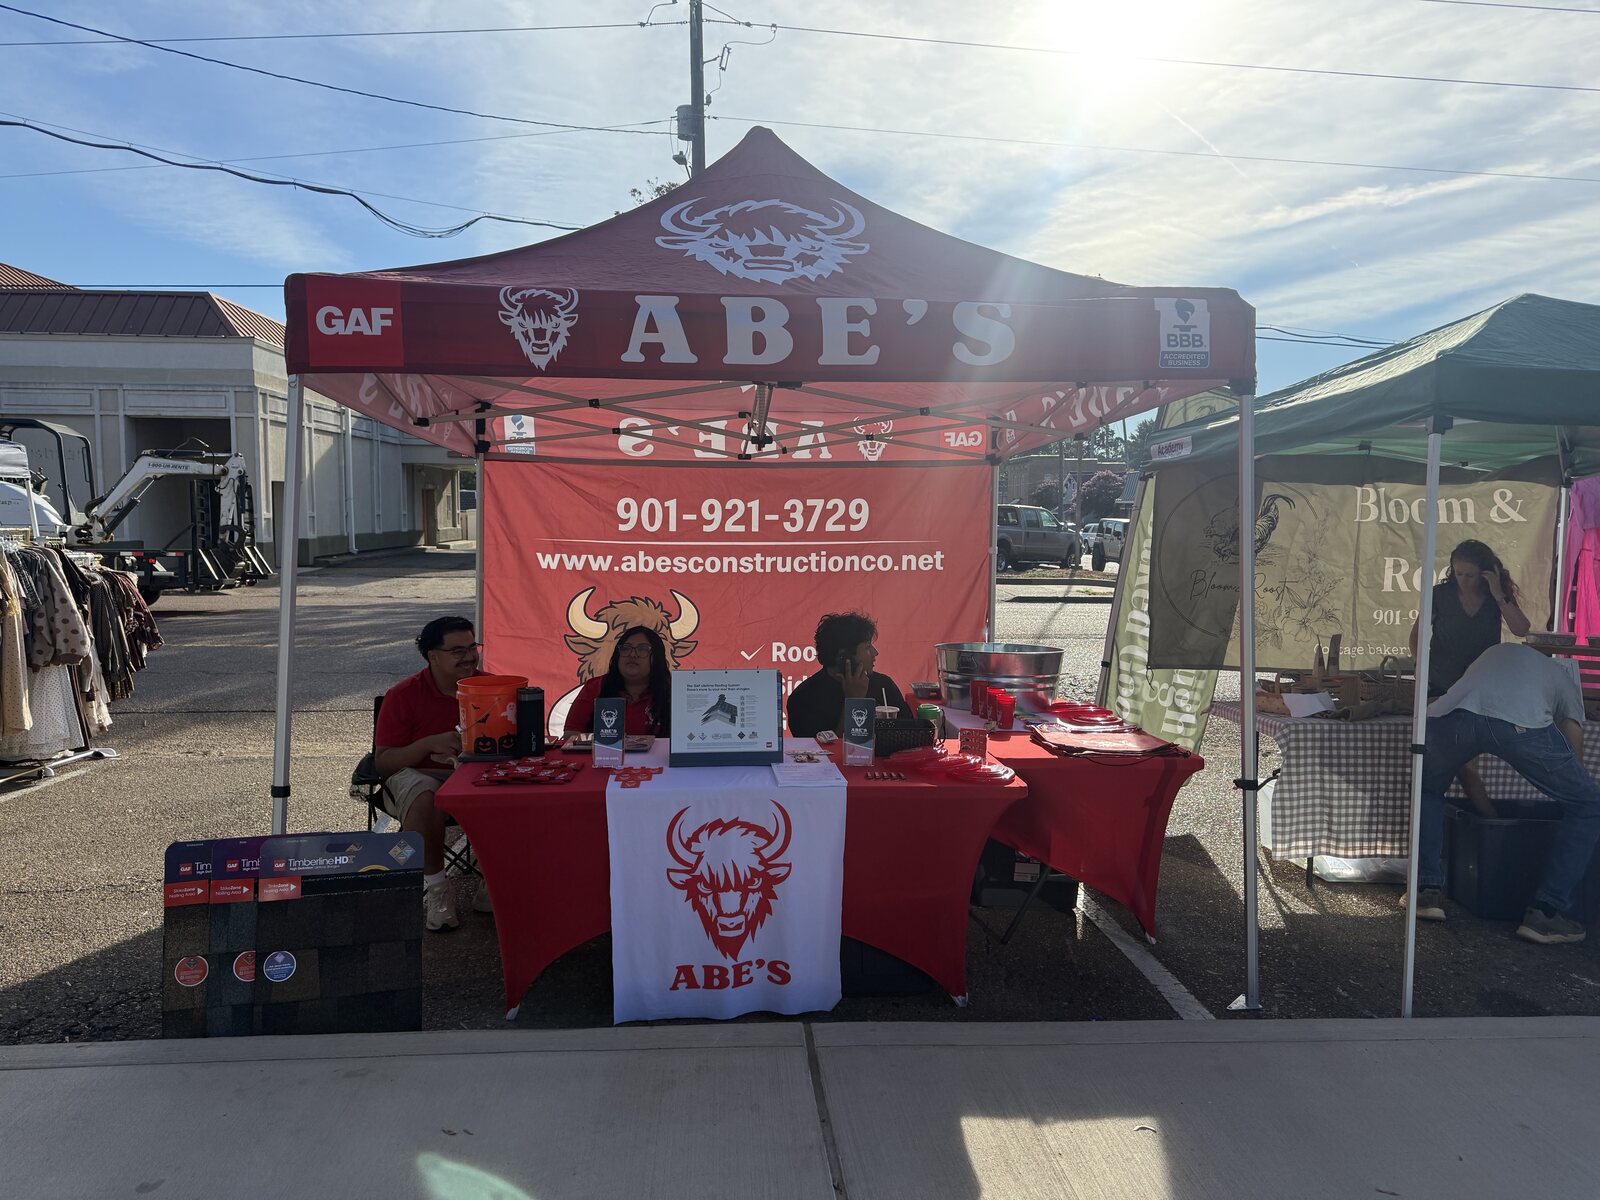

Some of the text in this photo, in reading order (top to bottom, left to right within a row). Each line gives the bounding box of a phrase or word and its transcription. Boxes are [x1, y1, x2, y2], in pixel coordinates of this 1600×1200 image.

[315, 305, 394, 336] GAF
[620, 295, 1016, 367] ABE'S
[616, 497, 870, 533] 901-921-3729
[1489, 488, 1528, 523] &
[536, 550, 945, 574] www.abesconstructionco.net
[771, 642, 818, 662] Roo
[1313, 643, 1365, 657] Cotage
[194, 861, 212, 870] Tim
[669, 958, 792, 991] ABE'S
